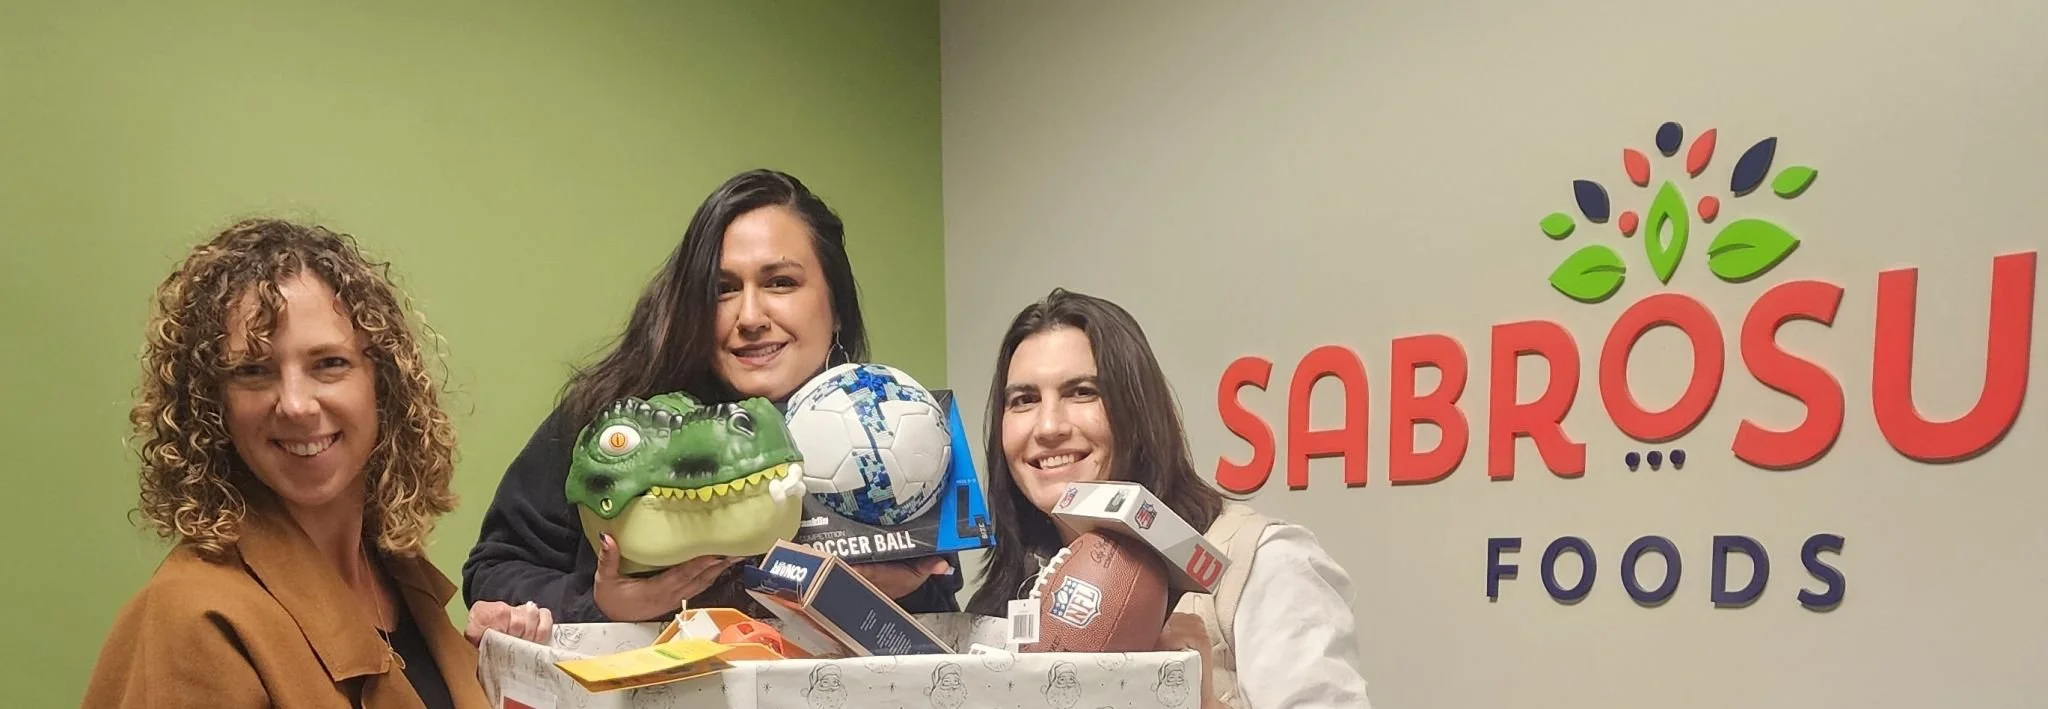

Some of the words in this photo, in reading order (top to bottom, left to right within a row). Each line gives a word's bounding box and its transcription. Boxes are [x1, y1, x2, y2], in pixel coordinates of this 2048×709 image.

[1215, 251, 2037, 493] SABROSU
[802, 535, 873, 557] OCCER
[874, 530, 916, 552] BALL
[1486, 533, 1846, 611] FOODS
[1065, 590, 1096, 623] NFL
